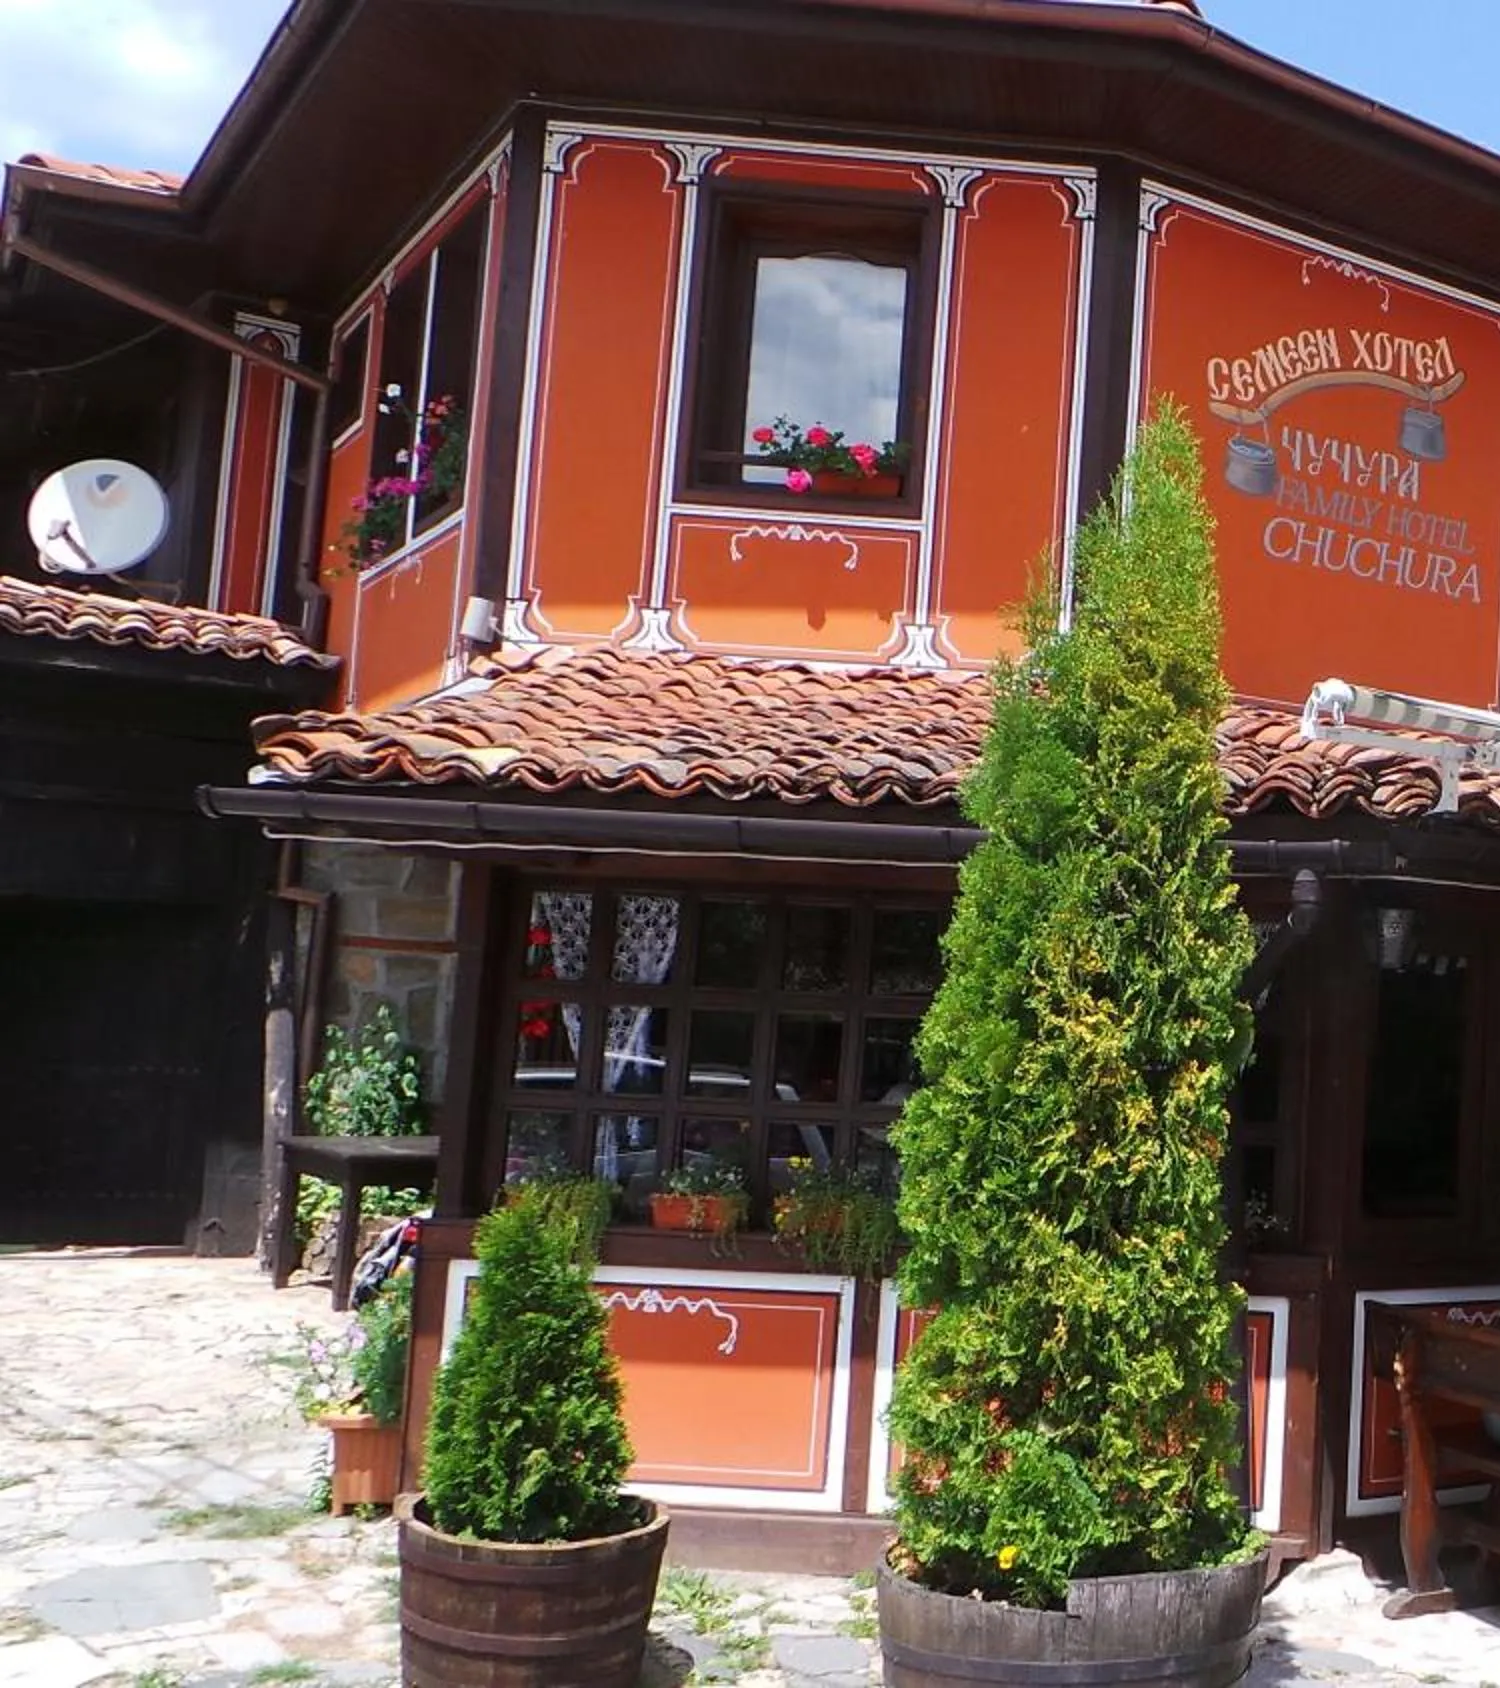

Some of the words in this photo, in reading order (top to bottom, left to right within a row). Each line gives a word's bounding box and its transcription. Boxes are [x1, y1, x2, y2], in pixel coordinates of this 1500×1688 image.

[1276, 476, 1380, 532] FAMILY
[1387, 506, 1476, 555] HOTEL
[1264, 517, 1481, 603] CHUCHURA
